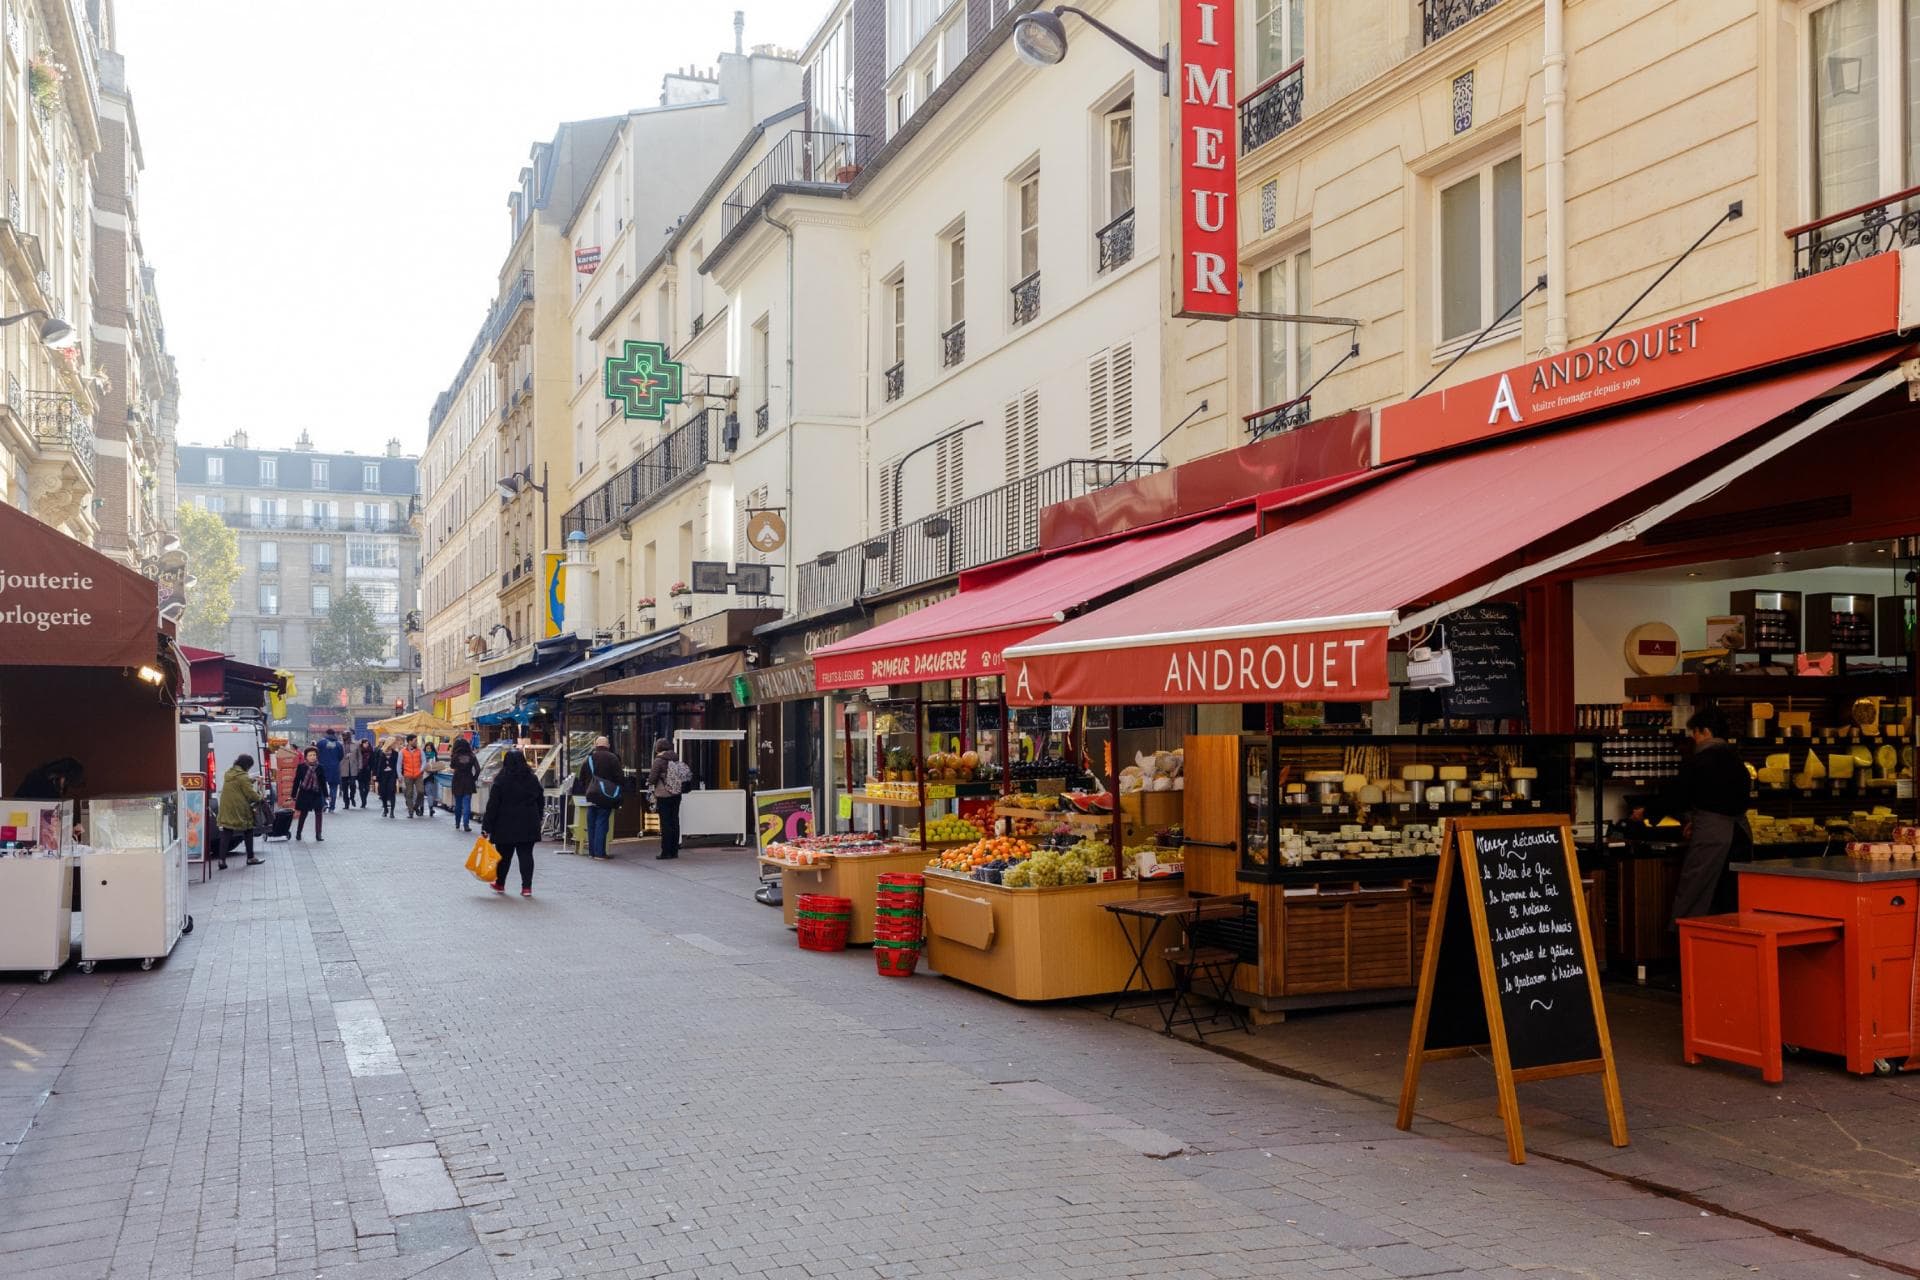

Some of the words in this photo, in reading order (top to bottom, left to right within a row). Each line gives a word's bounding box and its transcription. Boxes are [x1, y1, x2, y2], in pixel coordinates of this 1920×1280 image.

[1531, 317, 1704, 393] ANDROUET
[1488, 373, 1523, 425] A
[1557, 389, 1593, 407] fromager
[1594, 381, 1621, 396] depuis
[1622, 376, 1641, 390] 1909
[871, 658, 910, 679] PRIMEUR
[914, 649, 968, 674] DAGUERRE
[1164, 639, 1366, 692] ANDROUET
[1016, 660, 1034, 701] A
[1477, 835, 1508, 857] Venez
[1496, 862, 1519, 880] bleu
[1521, 862, 1532, 879] de
[1529, 886, 1542, 899] du
[1539, 921, 1550, 934] des
[1538, 944, 1547, 958] de
